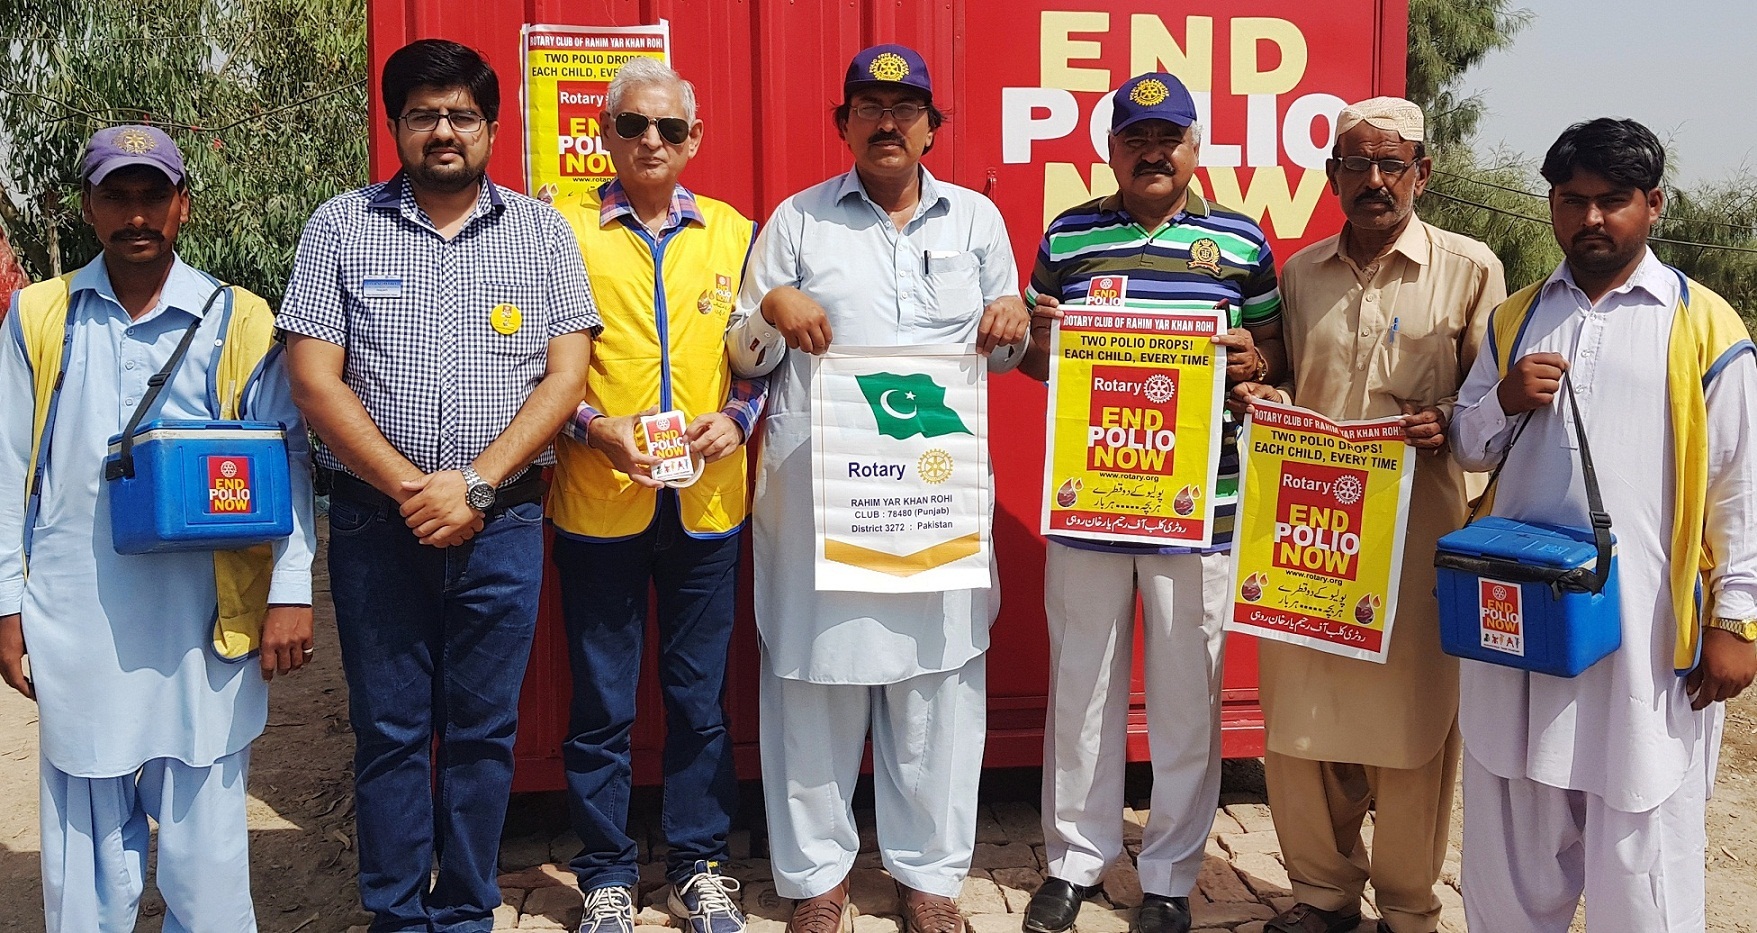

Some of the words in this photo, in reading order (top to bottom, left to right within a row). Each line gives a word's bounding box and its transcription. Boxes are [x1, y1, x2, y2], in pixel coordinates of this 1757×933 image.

[530, 36, 555, 46] ROTARY
[556, 37, 572, 47] CLUB
[575, 37, 583, 47] OF
[585, 38, 608, 48] RAHIM
[610, 38, 624, 48] YAR
[626, 38, 645, 48] KHAN
[646, 38, 662, 48] ROHI
[544, 54, 568, 63] TWO
[572, 54, 604, 64] POLIO
[1040, 10, 1308, 95] END
[532, 67, 558, 76] EACH
[561, 68, 596, 78] CHILD,
[600, 68, 618, 77] EVE
[560, 92, 604, 107] Rotary
[570, 118, 600, 138] EN
[558, 136, 610, 155] POL
[1088, 296, 1120, 306] POLIO
[1094, 290, 1117, 298] END
[1064, 315, 1093, 327] ROTARY
[1094, 316, 1112, 328] CLUB
[1115, 317, 1125, 328] OF
[1126, 318, 1152, 329] RAHIM
[1154, 319, 1170, 330] YAR
[1171, 320, 1194, 331] KHAN
[1196, 321, 1214, 332] ROHI
[1081, 336, 1107, 346] TWO
[1111, 336, 1145, 348] POLIO
[1150, 338, 1193, 350] DROPS!
[1064, 349, 1094, 360] EACH
[1098, 350, 1136, 364] CHILD,
[1140, 352, 1178, 364] EVERY
[1181, 354, 1209, 366] TIME
[1094, 378, 1142, 396] Rotary
[1102, 406, 1164, 430] END
[1254, 410, 1282, 424] ROTARY
[1284, 414, 1302, 427] CLUB
[1304, 417, 1314, 428] OF
[1315, 420, 1338, 434] RAHIM
[1340, 428, 1354, 439] YAR
[1356, 428, 1380, 438] KHAN
[654, 430, 678, 441] END
[1088, 426, 1176, 452] POLIO
[1271, 430, 1296, 442] TWO
[1300, 436, 1334, 448] POLIO
[1339, 440, 1382, 454] DROPS!
[656, 446, 684, 458] NOW
[1094, 446, 1166, 472] NOW
[1254, 442, 1284, 455] EACH
[1288, 446, 1326, 462] CHILD,
[1330, 452, 1367, 466] EVERY
[1370, 456, 1398, 470] TIME
[848, 462, 906, 480] Rotary
[1100, 472, 1159, 482] www.rotary.org
[216, 478, 244, 490] END
[1283, 474, 1331, 495] Rotary
[210, 488, 250, 500] POLIO
[851, 498, 880, 507] RAHIM
[883, 498, 900, 506] YAR
[904, 496, 928, 505] KHAN
[930, 494, 952, 503] ROHI
[214, 500, 247, 511] NOW
[854, 510, 880, 518] CLUB
[888, 510, 912, 518] 78480
[914, 507, 950, 517] (Punjab)
[852, 524, 882, 532] District
[885, 524, 905, 532] 3272
[918, 521, 953, 530] Pakistan
[1289, 504, 1349, 533] END
[1274, 522, 1360, 556] POLIO
[1280, 542, 1350, 576] NOW
[1285, 570, 1343, 586] www.rotary.org
[1488, 600, 1514, 612] END
[1482, 607, 1520, 624] POLIO
[1486, 618, 1516, 632] NOW
